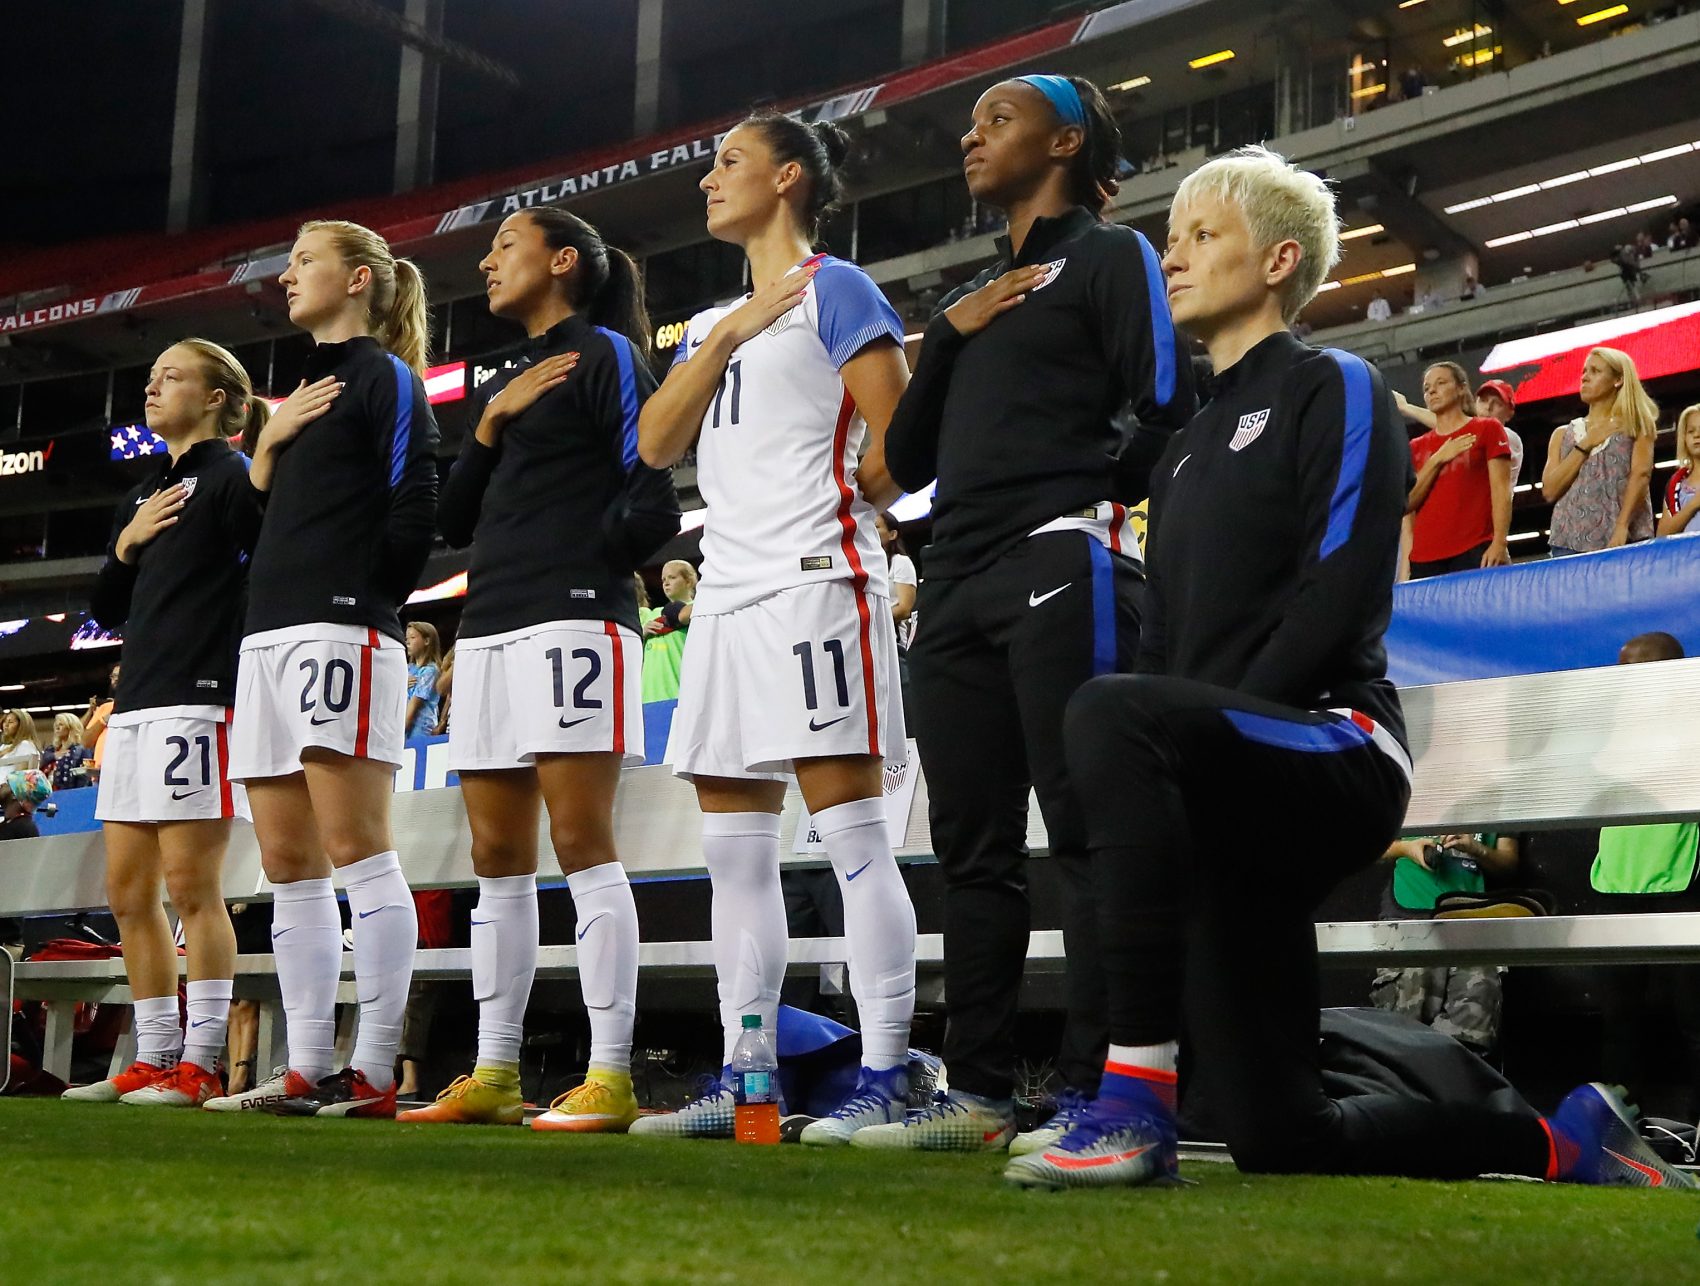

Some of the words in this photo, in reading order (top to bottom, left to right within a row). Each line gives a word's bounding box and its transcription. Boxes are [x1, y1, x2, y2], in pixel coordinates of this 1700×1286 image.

[502, 159, 639, 213] ATLANTA
[1240, 411, 1268, 430] USA
[299, 658, 354, 713] 20
[545, 647, 603, 709] 12
[792, 638, 850, 710] 11
[164, 735, 211, 786] 21
